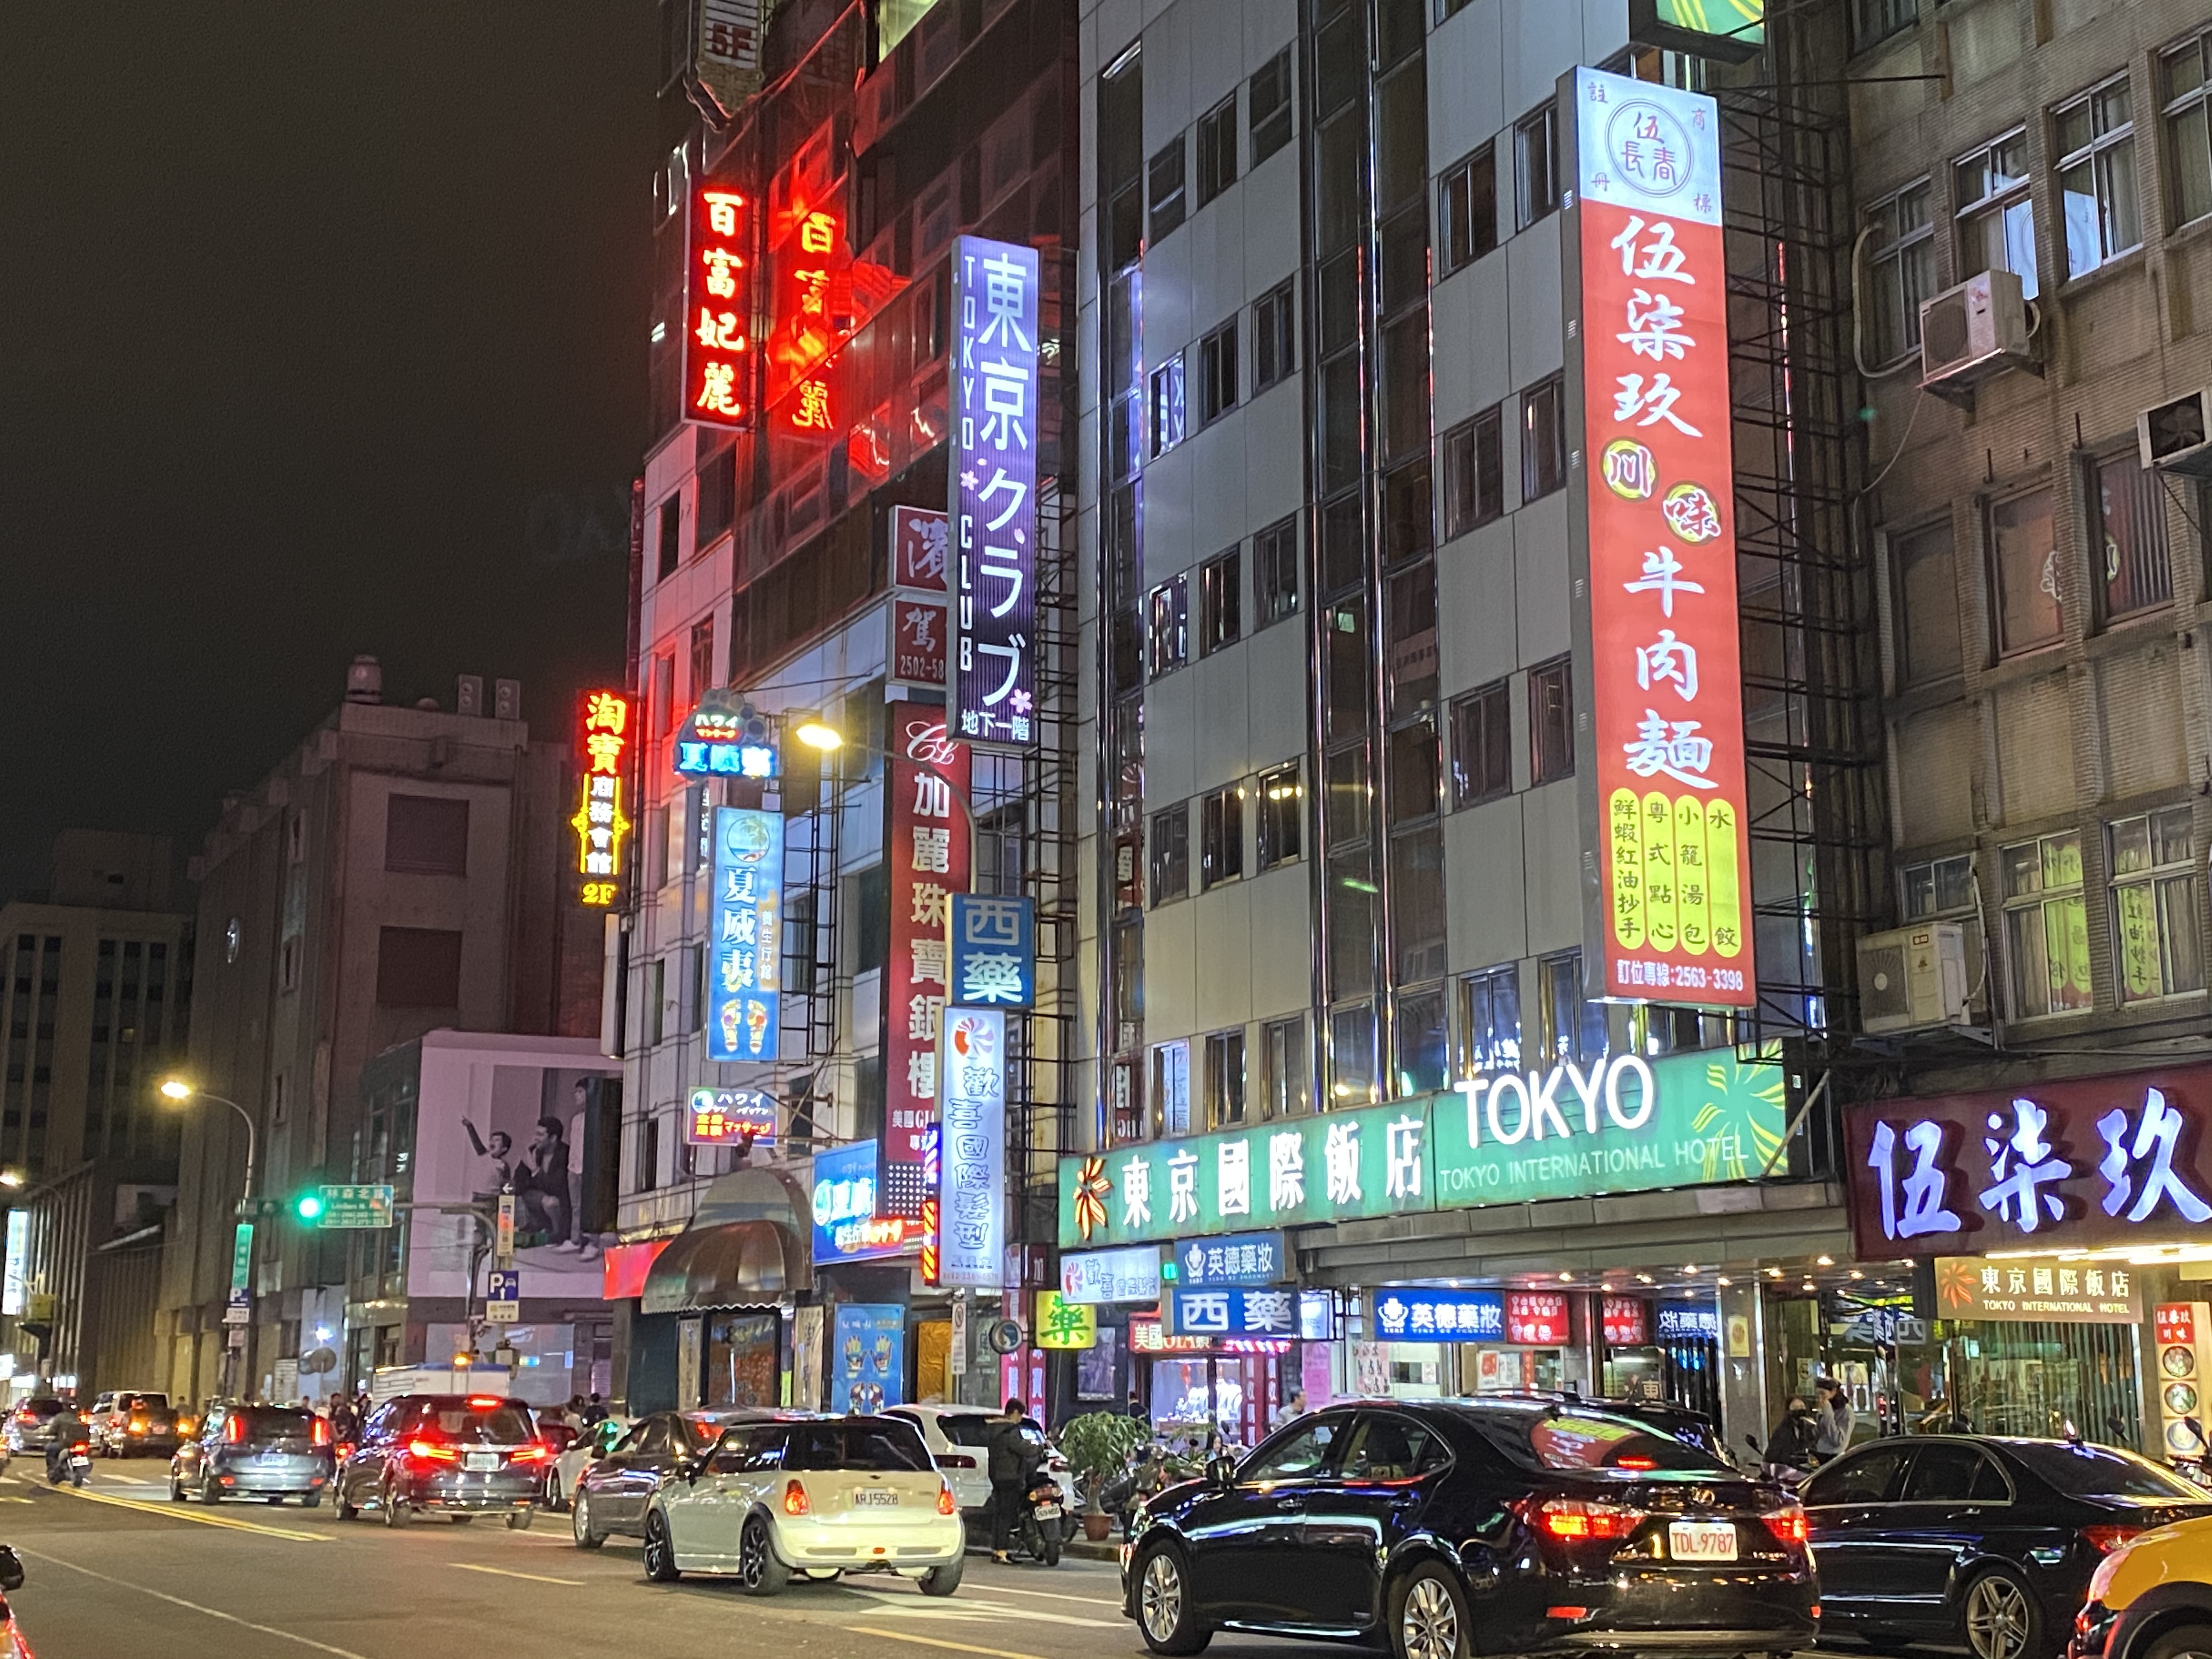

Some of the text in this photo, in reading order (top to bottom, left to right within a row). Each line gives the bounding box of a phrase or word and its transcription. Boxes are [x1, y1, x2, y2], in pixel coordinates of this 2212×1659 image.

[713, 23, 752, 59] 5F
[696, 193, 744, 415] 百富妃麗
[1611, 216, 1702, 437] 伍柒玖
[961, 256, 975, 672] TOKYO CLUB
[1607, 445, 1721, 537] 川味
[586, 693, 626, 774] 淘寶
[961, 709, 1029, 741] 地下一階
[582, 883, 616, 905] 2F
[1613, 799, 1640, 939] 鮮蝦紅油抄手
[1647, 801, 1674, 939] 粵式點心
[1679, 806, 1706, 945] 小籠湯包
[1709, 808, 1739, 947] 水餃
[721, 866, 757, 988] 夏威夷
[963, 899, 1023, 1003] 西藥
[718, 1093, 763, 1107] ハワイ
[1454, 1054, 1654, 1149] TOKYO
[1121, 1114, 1424, 1228] 東京國際飯店
[1441, 1135, 1749, 1192] TOKYO INTERNATIONAL HOTEL
[1868, 1087, 2212, 1240] 伍柒玖
[490, 1274, 504, 1294] P
[1207, 1242, 1274, 1276] 英德藥妝
[1980, 1266, 2130, 1297] 東京國際飯店
[1180, 1290, 1291, 1331] 西藥
[1411, 1304, 1502, 1329] 英德藥妝
[1983, 1300, 2130, 1313] TOKYO INTERNATIONAL HOTEL
